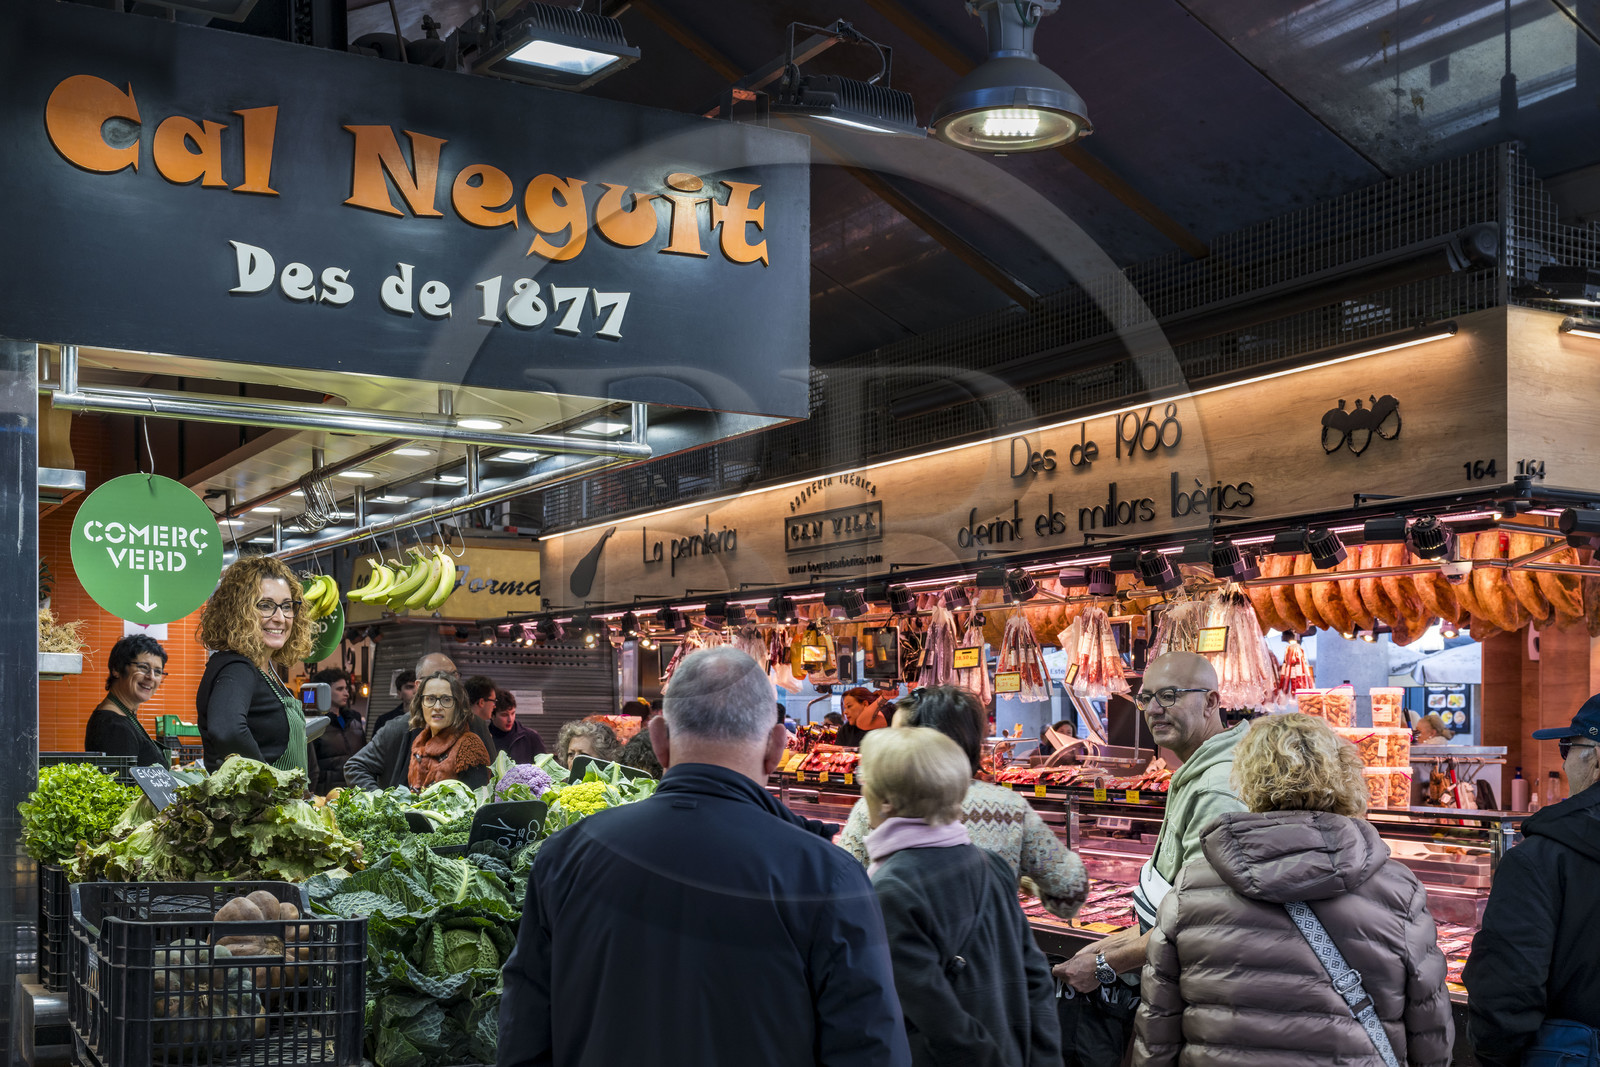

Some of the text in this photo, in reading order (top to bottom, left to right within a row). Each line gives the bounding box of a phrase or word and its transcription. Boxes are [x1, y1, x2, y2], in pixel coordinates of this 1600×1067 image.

[46, 74, 769, 267] Cal Neguit
[229, 240, 631, 339] Des de 1877
[1010, 403, 1183, 478] Des de 1968
[1463, 459, 1497, 480] 164
[1516, 459, 1546, 480] 164
[791, 511, 877, 541] CAN VILA
[958, 499, 1023, 548] oferint
[1035, 493, 1066, 535] els
[1079, 482, 1156, 531] millors
[83, 520, 208, 556] COMERÇ
[643, 526, 664, 564] La
[106, 547, 187, 572] VERD
